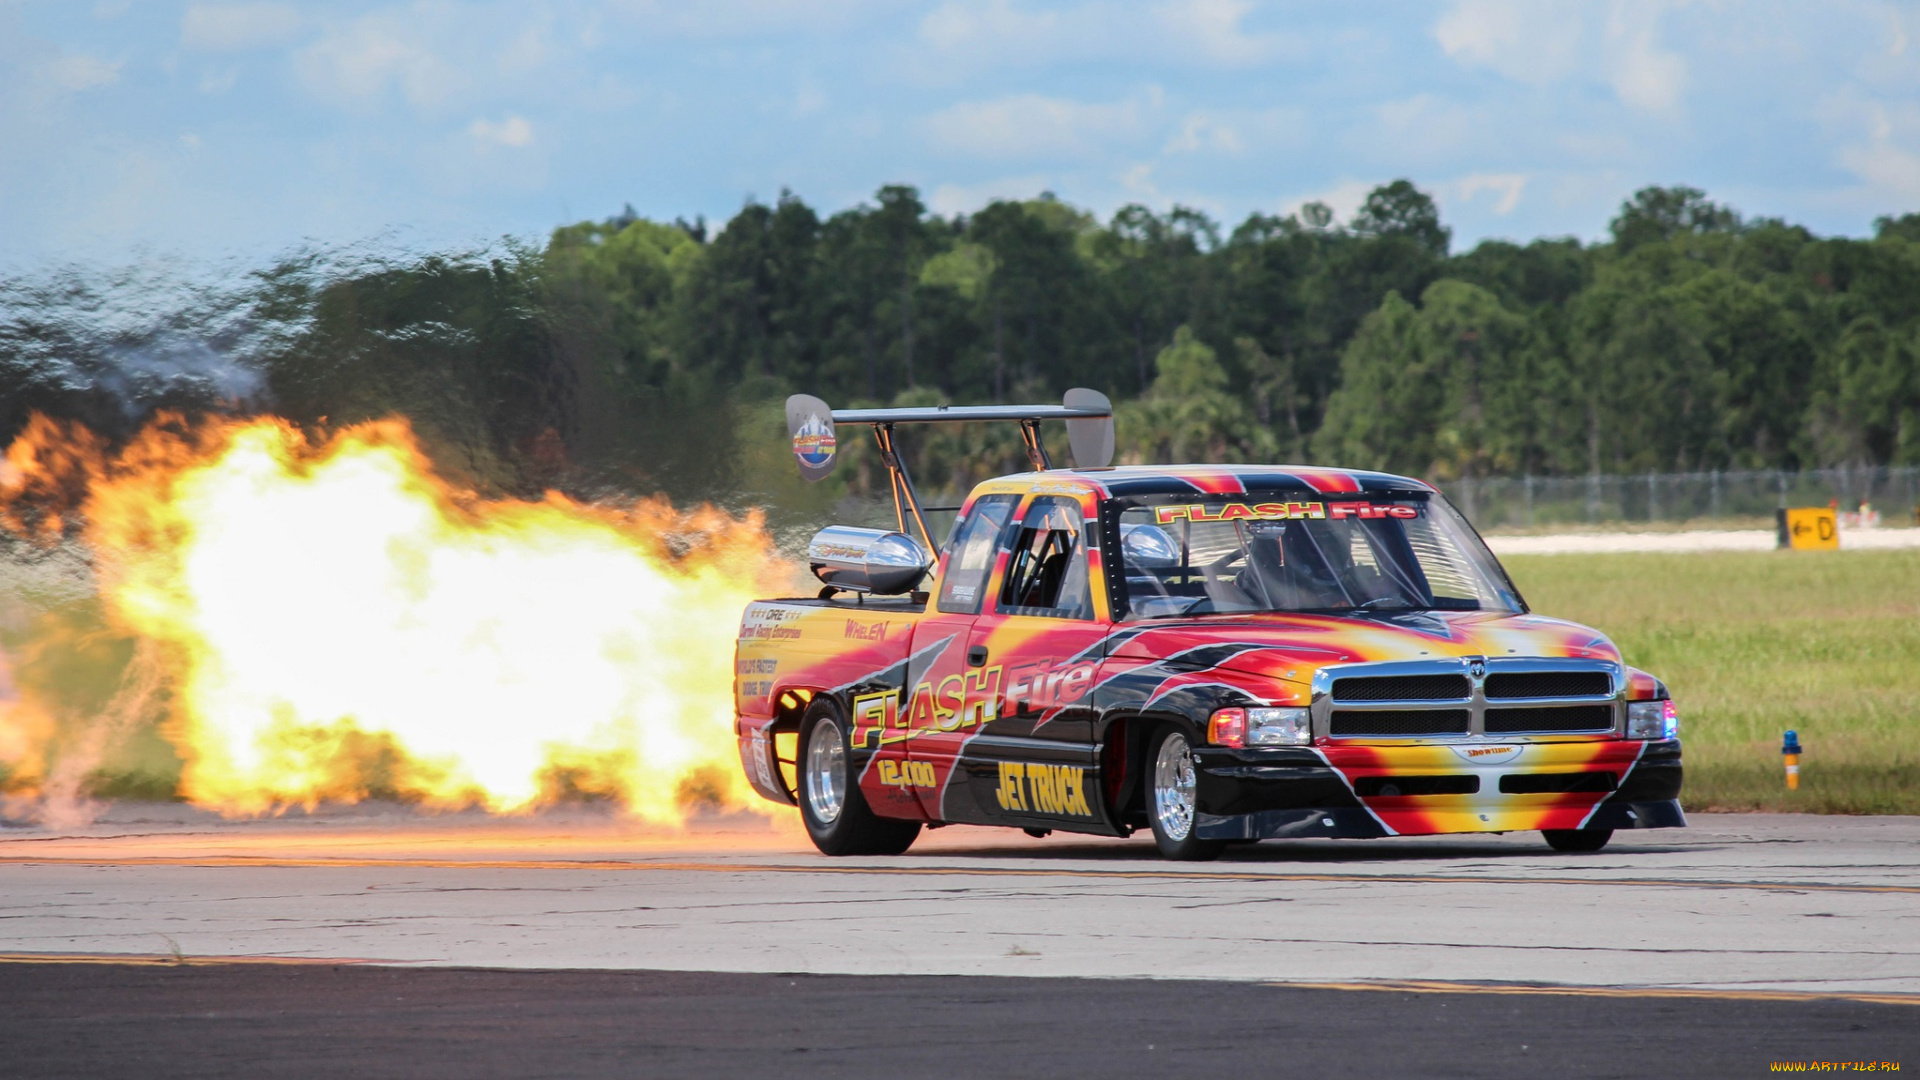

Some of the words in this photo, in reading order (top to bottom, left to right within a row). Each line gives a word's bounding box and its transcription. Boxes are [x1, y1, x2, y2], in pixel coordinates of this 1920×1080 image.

[1155, 502, 1326, 525] FLASH
[1327, 500, 1418, 520] Fire
[1818, 516, 1833, 541] D
[765, 609, 786, 621] DRE
[844, 618, 890, 641] WHELEN
[851, 665, 1003, 749] FLASH
[1001, 657, 1097, 718] Fire
[877, 759, 937, 790] 12,000
[995, 761, 1029, 811] JET
[1027, 762, 1093, 816] TRUCK
